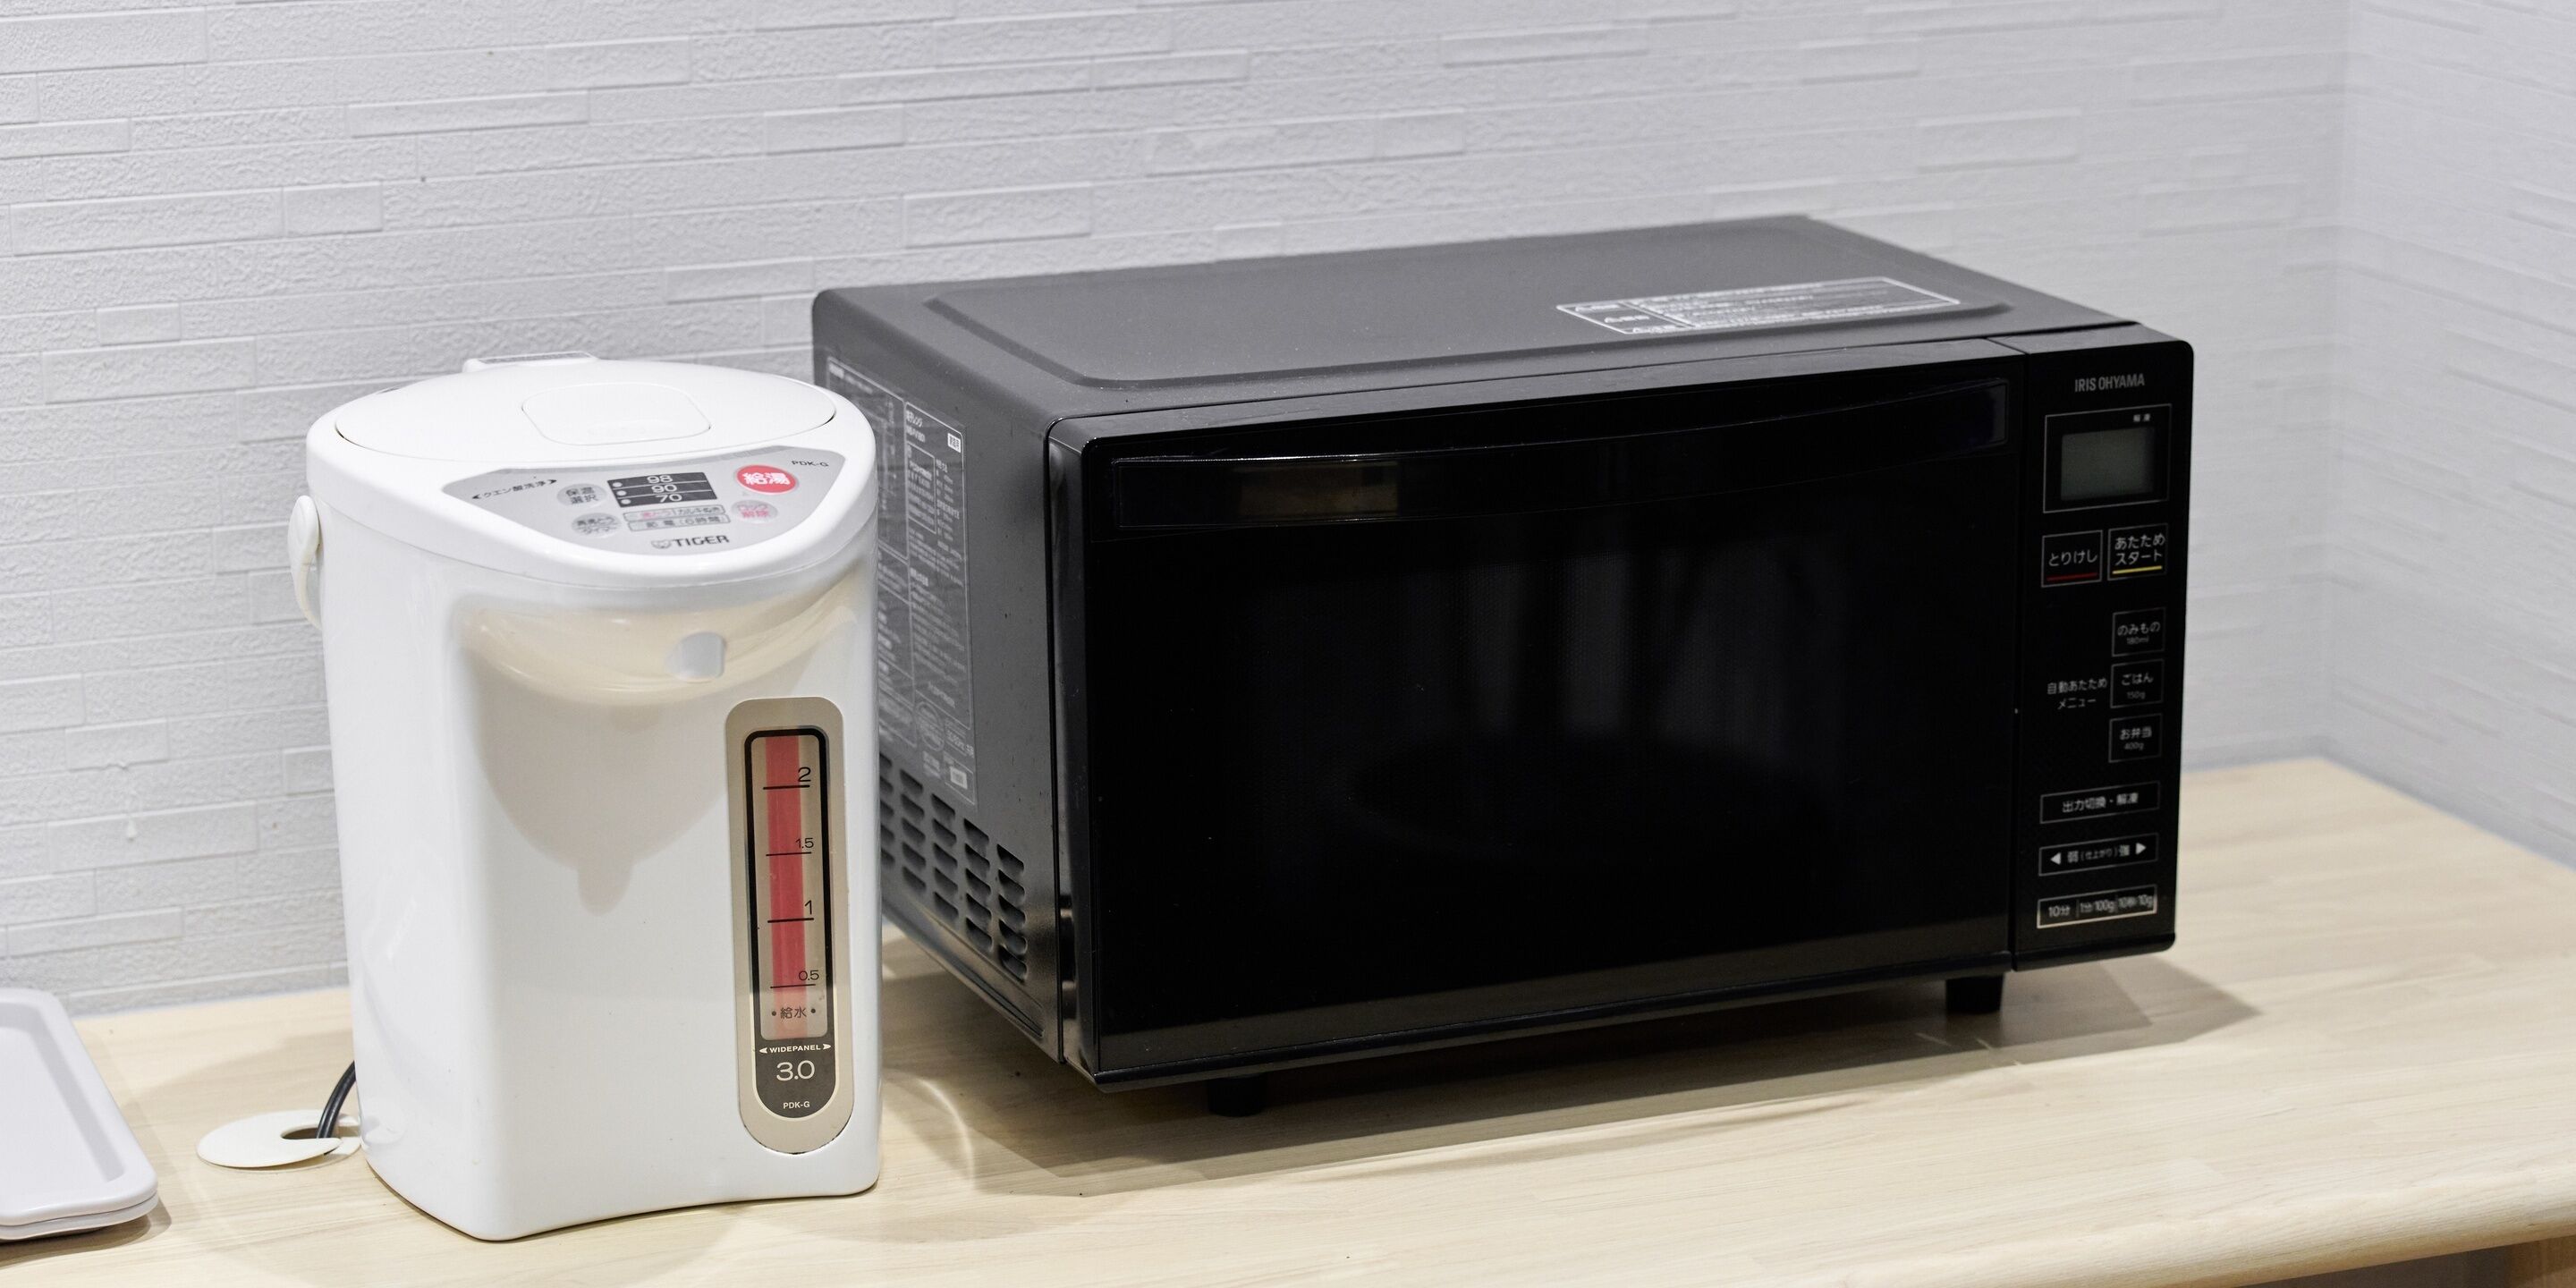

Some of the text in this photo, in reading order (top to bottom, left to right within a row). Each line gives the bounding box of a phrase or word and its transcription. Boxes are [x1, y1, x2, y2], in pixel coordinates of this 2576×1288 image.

[2074, 373, 2145, 392] IRIS OHYAMA
[647, 474, 674, 484] 98
[742, 472, 791, 485] 給湯
[651, 484, 677, 493] 90
[655, 493, 682, 503] 70
[672, 535, 730, 547] TIGER
[2114, 532, 2165, 551] あたため
[2048, 549, 2097, 567] とりけし
[2114, 548, 2163, 565] スタート
[2117, 621, 2162, 636] のみもの
[2121, 672, 2155, 686] ごはん
[2046, 678, 2108, 695] 自動あたため
[2057, 698, 2097, 710] メニュー
[2119, 725, 2153, 741] お弁当
[797, 767, 811, 783] 2
[795, 837, 814, 849] 1.5
[804, 900, 812, 915] 1
[798, 970, 819, 981] 0.5
[780, 1007, 808, 1020] 給水
[769, 1044, 821, 1054] WIDEPANEL
[775, 1060, 815, 1081] 3.0
[783, 1101, 810, 1109] PDK-G
